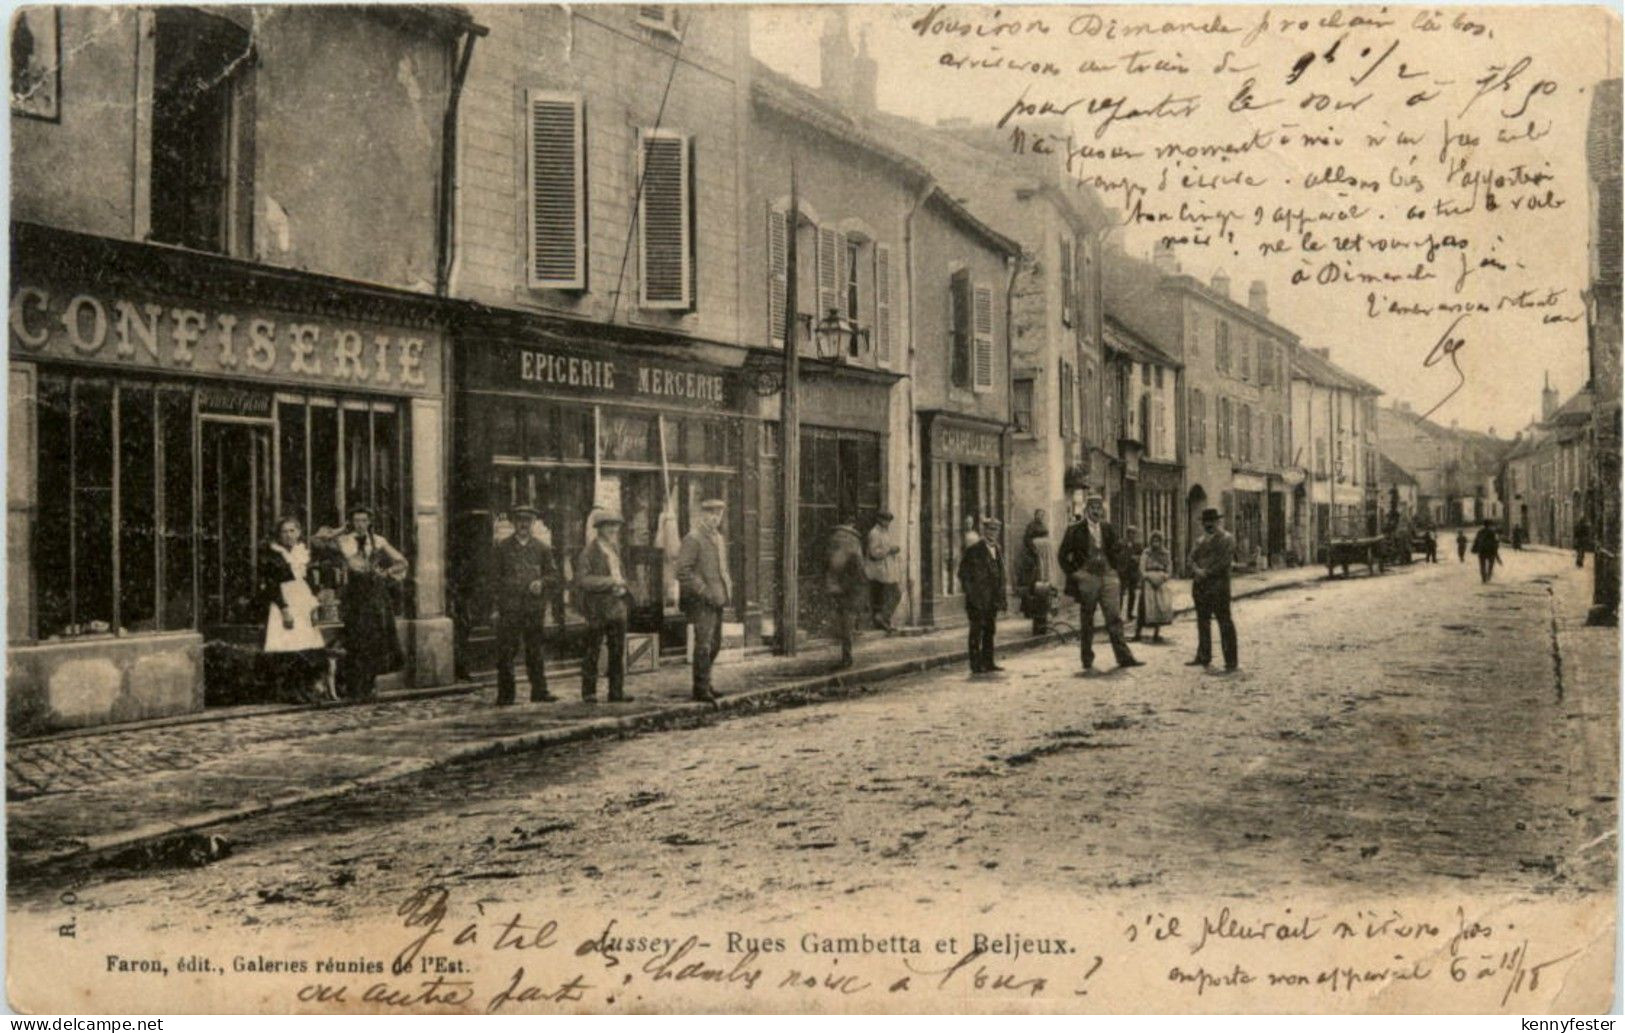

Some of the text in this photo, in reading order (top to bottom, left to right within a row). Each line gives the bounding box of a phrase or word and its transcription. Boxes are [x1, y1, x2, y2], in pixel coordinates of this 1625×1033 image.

[1068, 14, 1242, 36] Dimanche
[1243, 7, 1396, 47] prochain
[1124, 51, 1189, 74] train
[998, 84, 1082, 130] pour
[1228, 78, 1286, 113] le
[1299, 92, 1375, 111] soir
[1155, 131, 1276, 161] moment
[1301, 231, 1326, 252] le
[1316, 258, 1438, 286] Dimanche
[10, 286, 428, 388] CONFISERIE
[520, 350, 724, 401] EPICERIE MERCERIE
